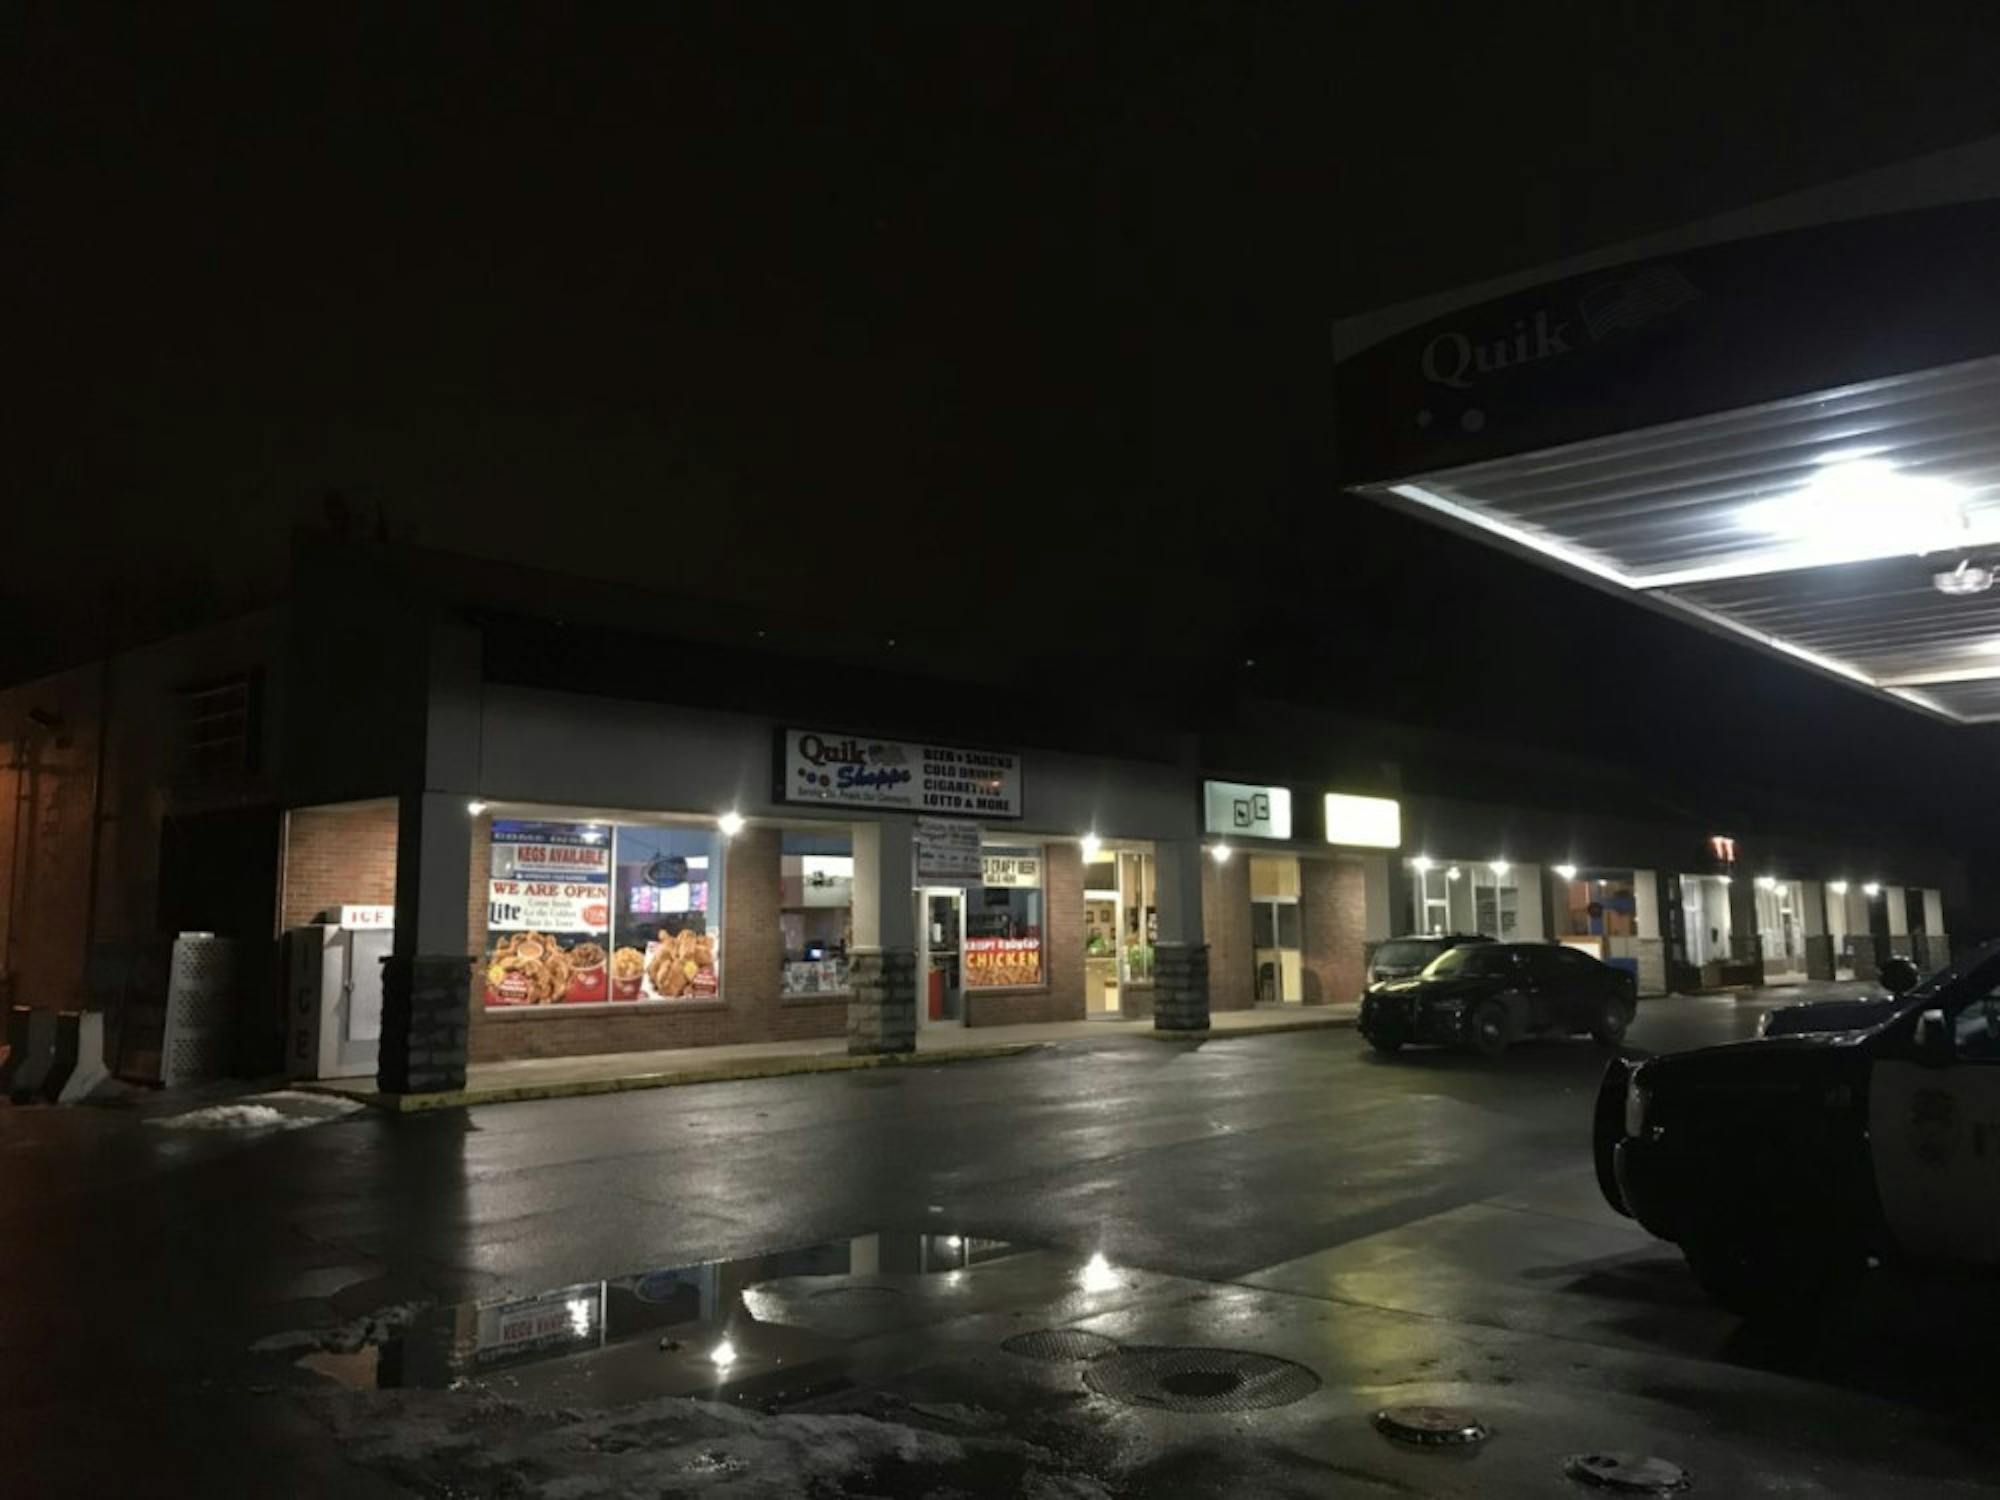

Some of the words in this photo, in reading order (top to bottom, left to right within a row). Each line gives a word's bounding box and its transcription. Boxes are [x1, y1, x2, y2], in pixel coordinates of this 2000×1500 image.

[1421, 308, 1574, 389] Quik
[799, 735, 867, 766] Quik
[837, 766, 912, 790] Shoppe
[924, 764, 956, 777] COLD
[924, 793, 962, 808] LOTTO
[977, 798, 1009, 811] MORE
[518, 847, 546, 863] KEGS
[549, 847, 605, 866] AVAILABLE
[494, 881, 519, 895] WE
[525, 884, 559, 897] ARE
[563, 886, 608, 899] OPEN
[351, 911, 385, 923] ICE
[490, 902, 521, 924] Lite
[967, 951, 1039, 969] CHICKEN
